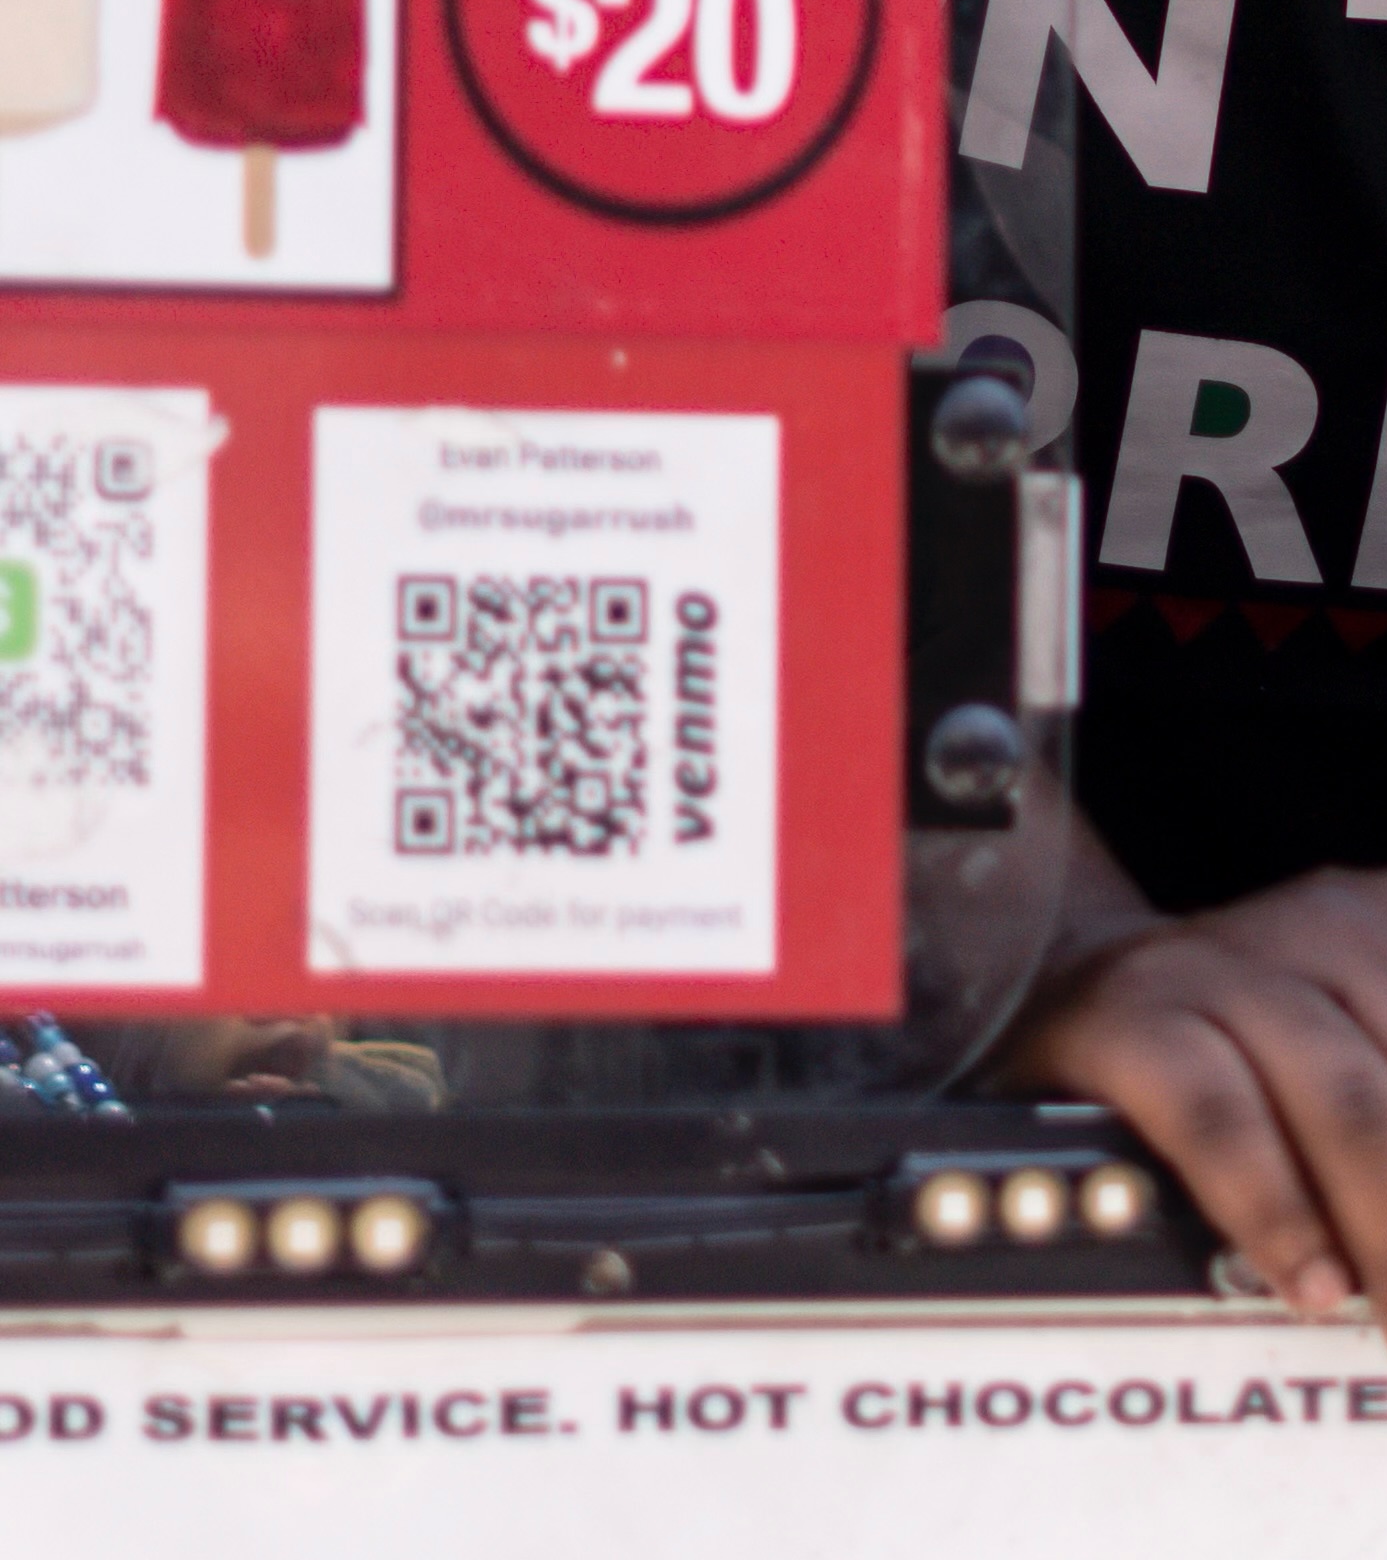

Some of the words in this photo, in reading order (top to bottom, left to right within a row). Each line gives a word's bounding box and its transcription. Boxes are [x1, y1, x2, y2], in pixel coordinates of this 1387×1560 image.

[675, 591, 718, 844] venmo
[142, 1388, 578, 1443] SERVICE.
[616, 1385, 808, 1433] HOT
